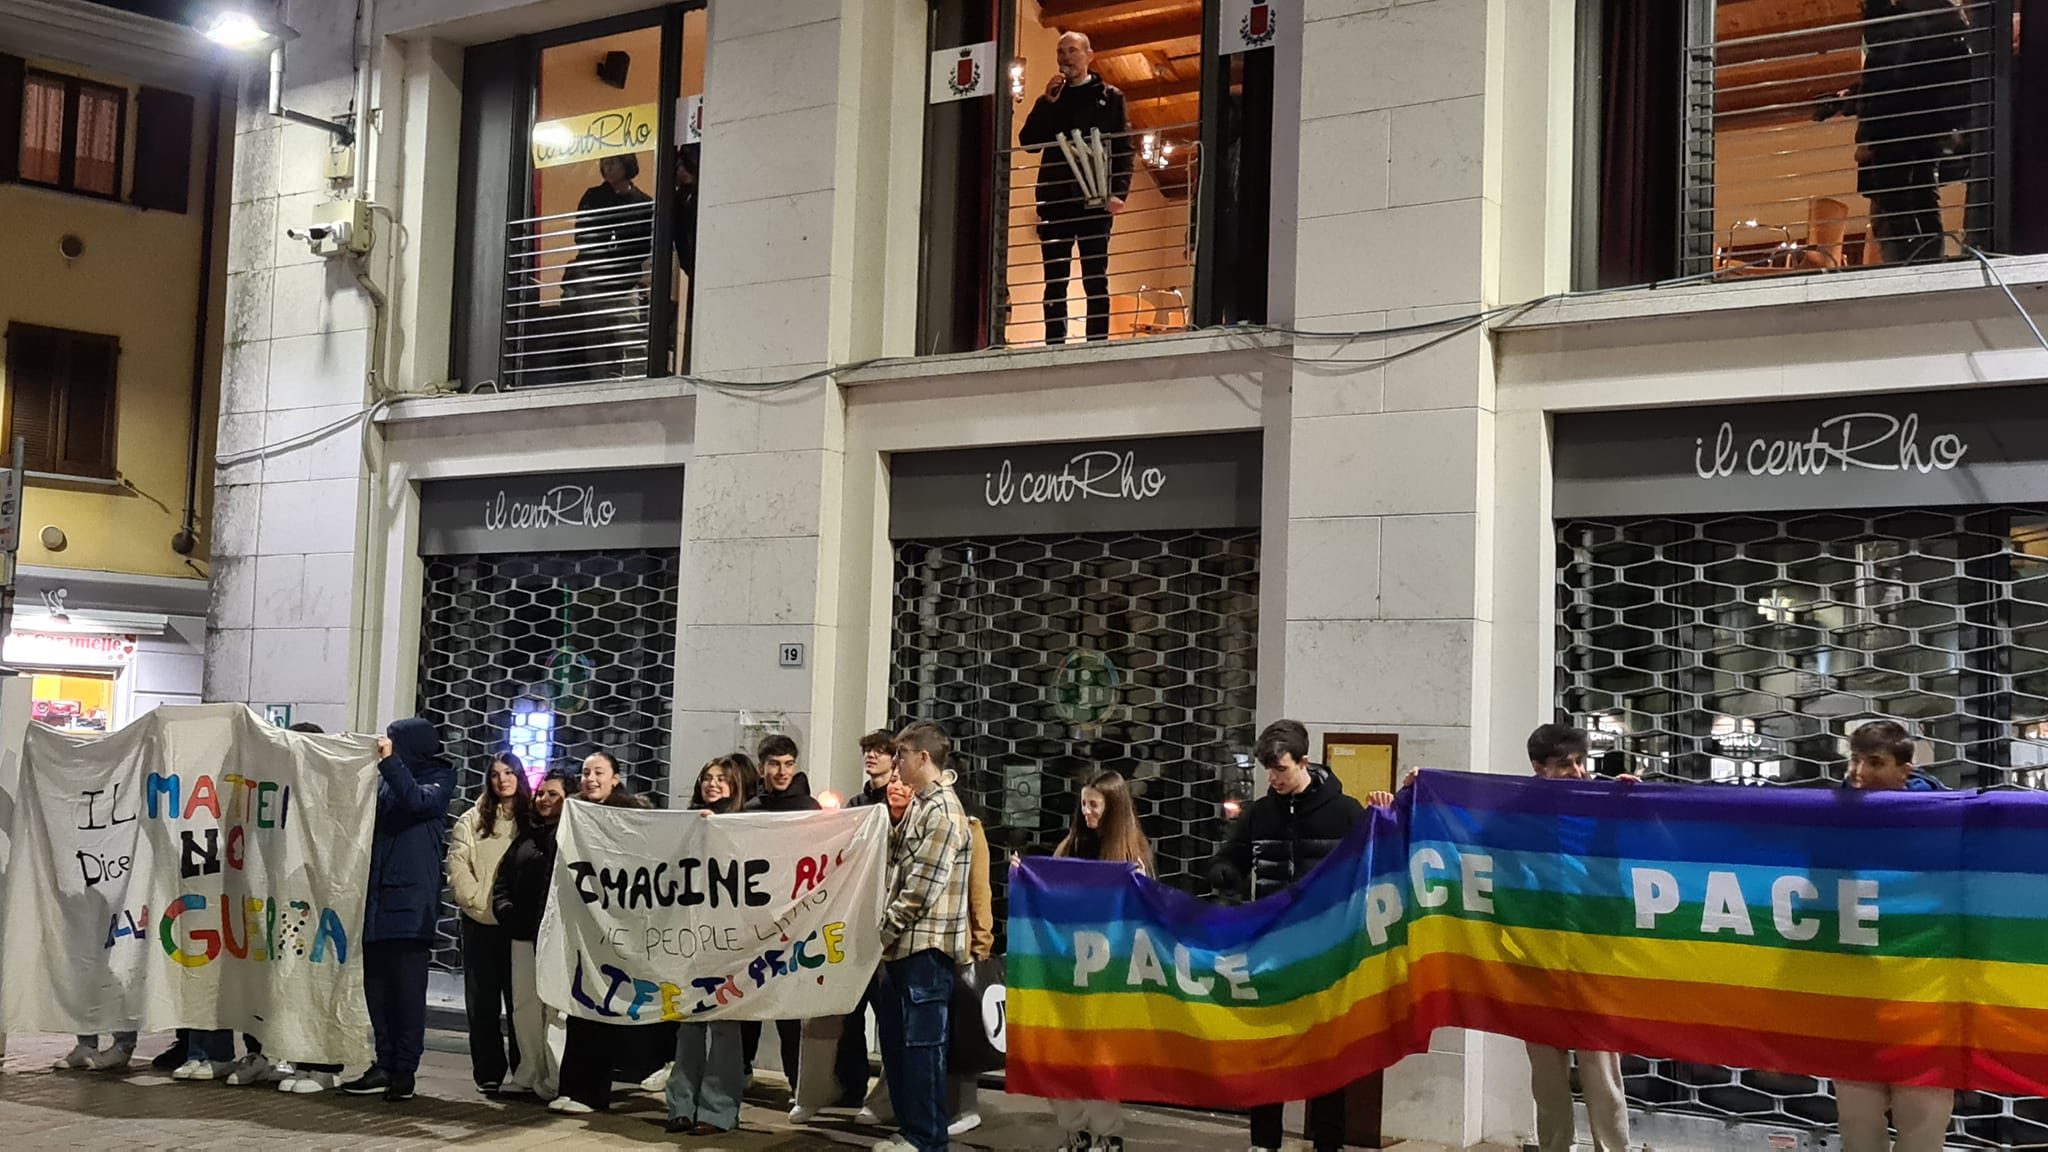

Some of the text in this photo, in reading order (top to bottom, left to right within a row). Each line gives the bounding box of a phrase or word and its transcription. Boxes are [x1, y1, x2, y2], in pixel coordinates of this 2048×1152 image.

[1695, 412, 1968, 479] il centRho
[985, 450, 1166, 507] il centRho
[485, 485, 617, 531] il centRho
[784, 647, 798, 661] 19
[78, 772, 290, 830] IL MATTEI
[76, 825, 245, 887] Dice NO
[568, 857, 772, 909] IMAGINE
[1631, 866, 1880, 947] PACE
[646, 924, 745, 961] PEOPLE
[572, 949, 689, 1021] LIFE
